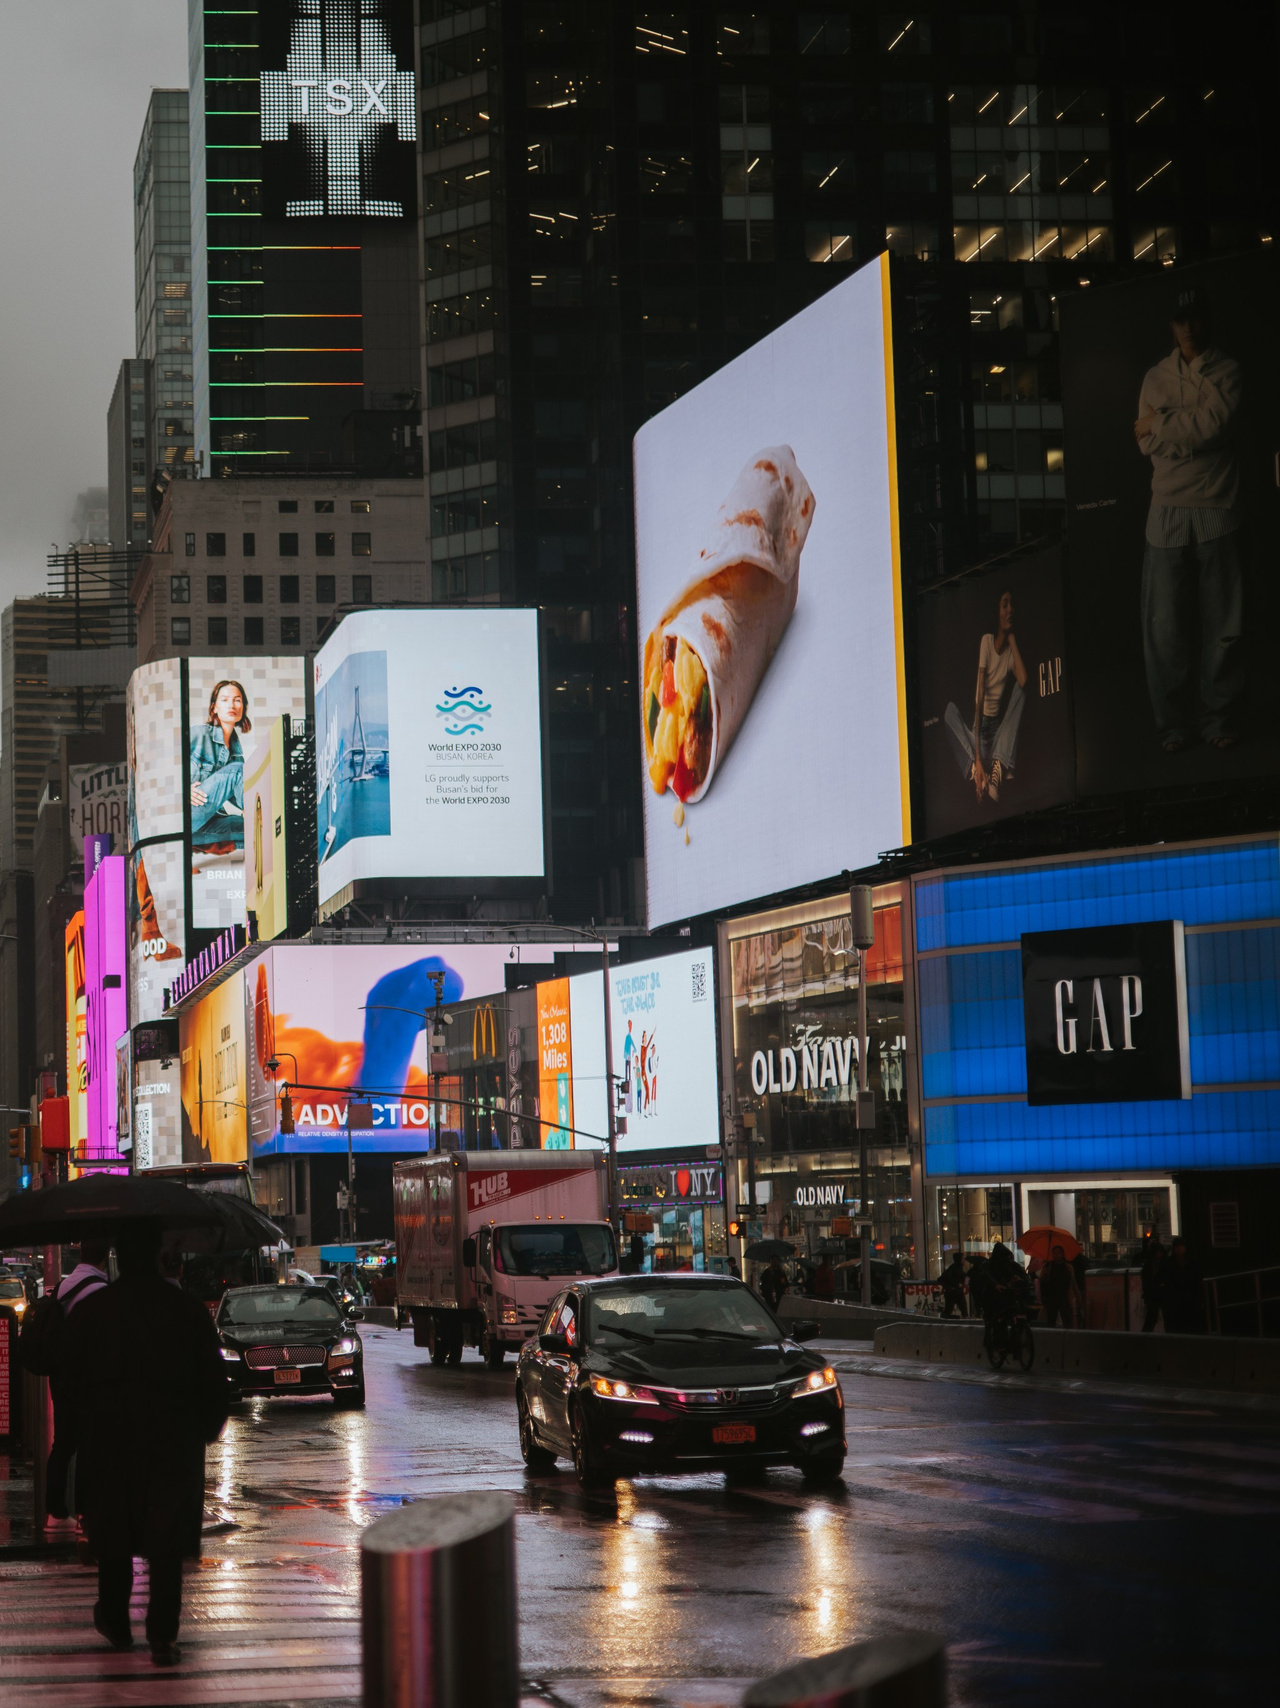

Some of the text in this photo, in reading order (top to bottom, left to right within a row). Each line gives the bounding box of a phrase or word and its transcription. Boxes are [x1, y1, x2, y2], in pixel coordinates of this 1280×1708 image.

[291, 79, 389, 115] TSX
[1038, 656, 1062, 698] GAP
[428, 743, 502, 751] World EXPO 2030
[436, 753, 465, 761] BUSAN,
[425, 774, 509, 784] LG proudly supports
[436, 785, 498, 793] Busan's bid for
[425, 797, 510, 805] the World EXPO 2030
[206, 870, 243, 880] BRIAN
[541, 1009, 549, 1022] New
[1055, 975, 1144, 1055] GAP
[541, 1021, 567, 1049] 1,308
[543, 1049, 568, 1071] Miles
[751, 1048, 797, 1096] OLD
[298, 1103, 447, 1125] ADVCTION
[470, 1171, 509, 1206] HUB
[670, 1169, 677, 1197] I
[796, 1185, 846, 1206] OLD NAVY
[905, 1284, 969, 1296] CHICO
